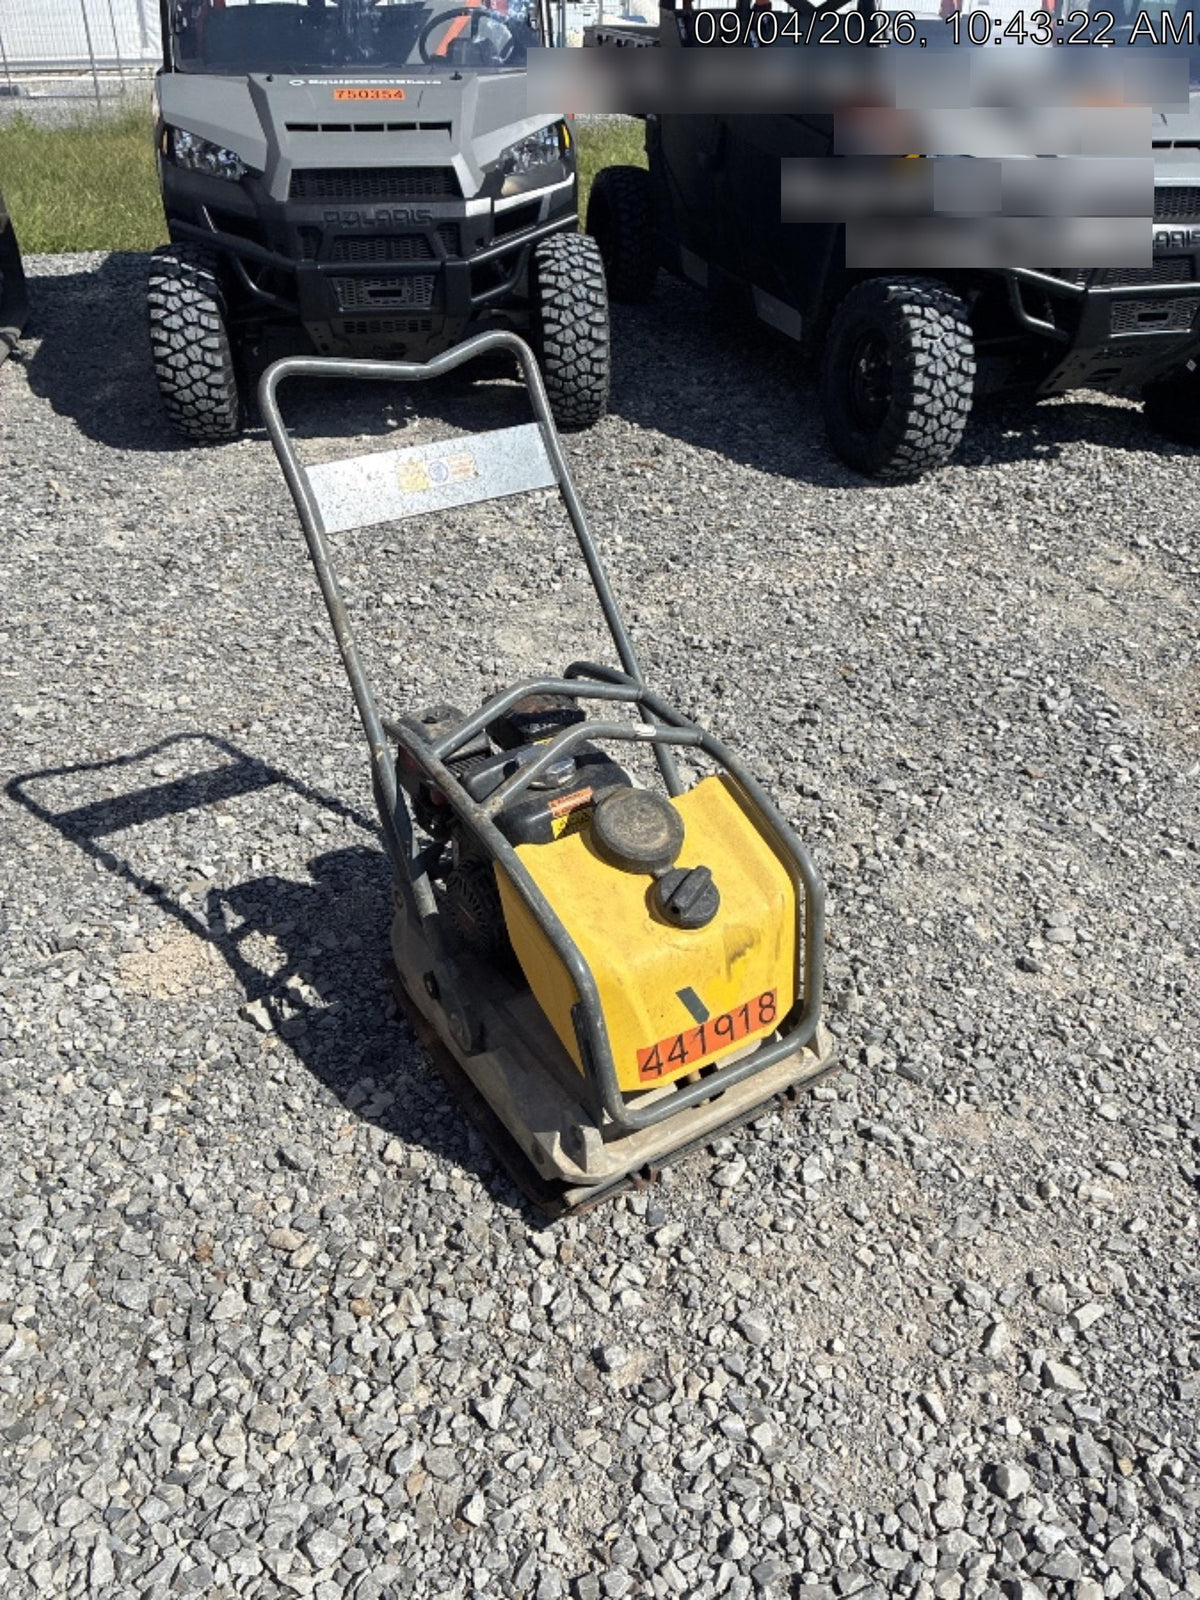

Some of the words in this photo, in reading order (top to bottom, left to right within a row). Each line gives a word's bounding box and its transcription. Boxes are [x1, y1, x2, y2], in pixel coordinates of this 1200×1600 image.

[336, 89, 403, 99] 750354
[323, 209, 433, 226] POLARIS
[1154, 230, 1200, 248] ARIS
[641, 991, 777, 1076] 441918
